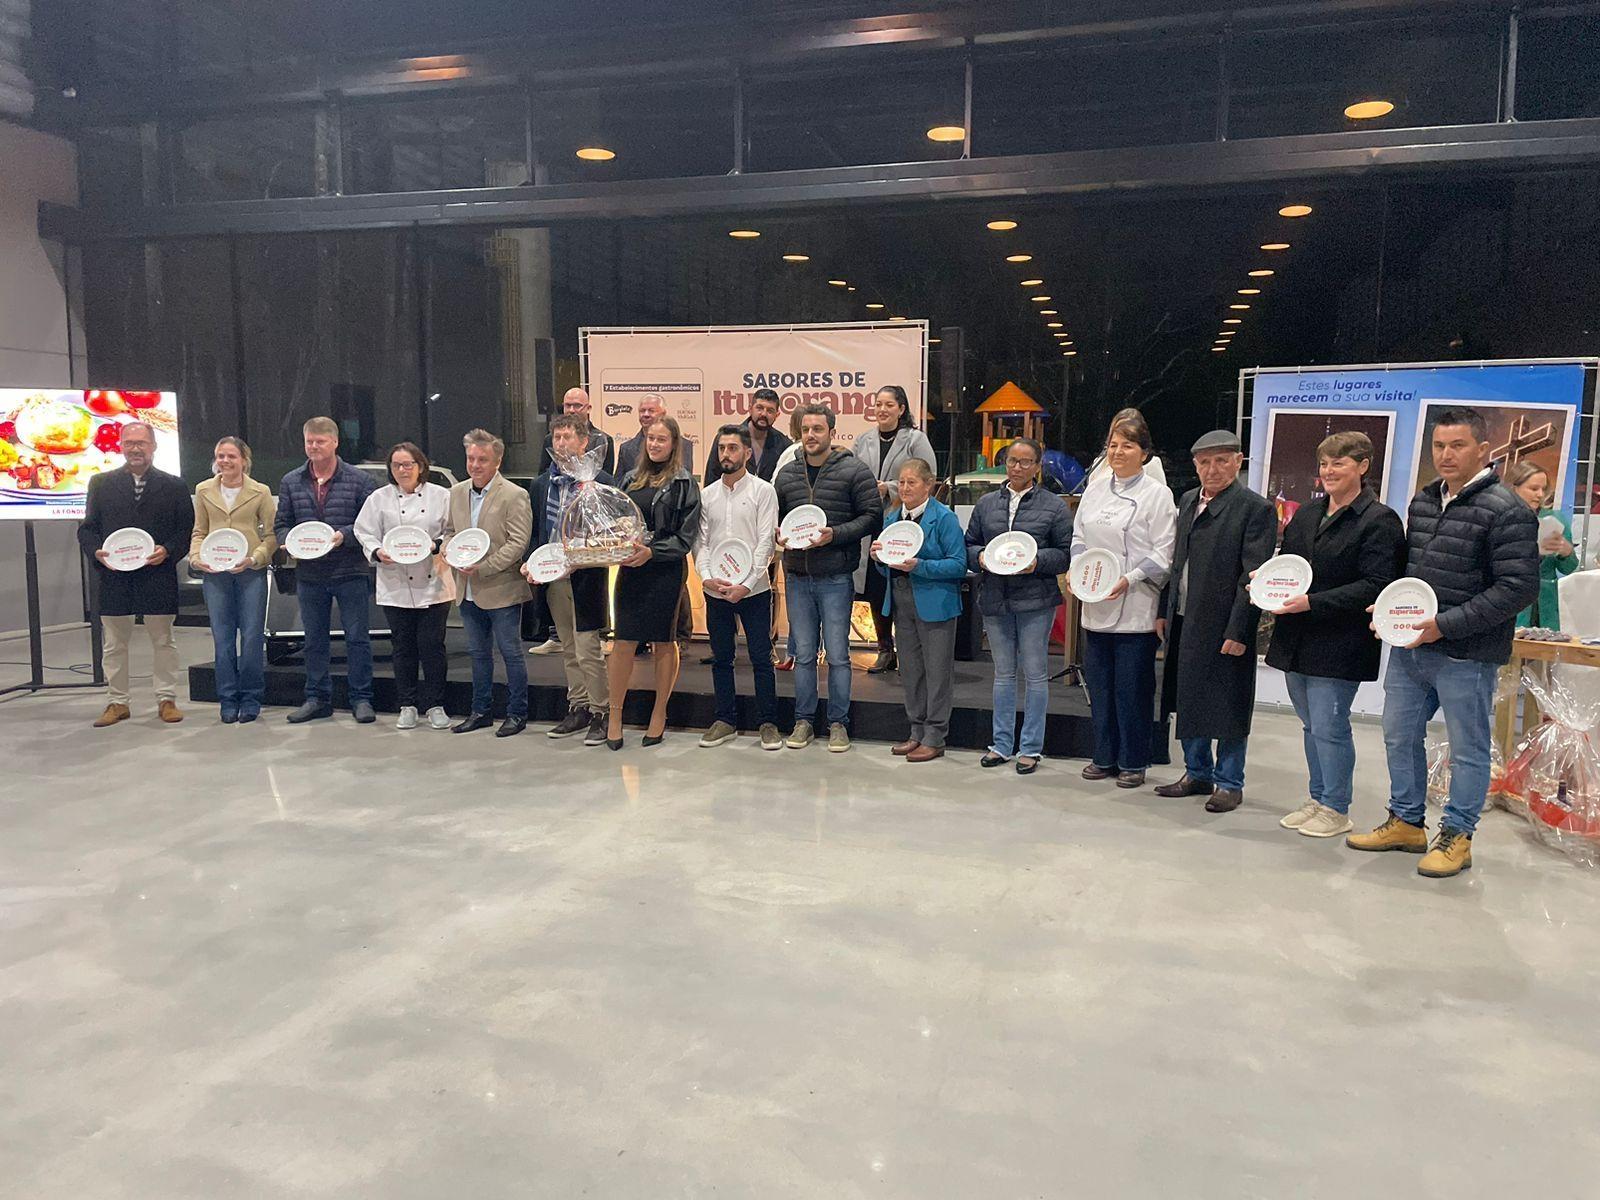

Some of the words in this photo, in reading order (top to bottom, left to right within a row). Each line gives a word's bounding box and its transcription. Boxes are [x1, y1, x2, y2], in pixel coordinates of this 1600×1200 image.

[742, 372, 833, 389] SABORES
[838, 371, 866, 387] DE
[1298, 380, 1330, 391] Estes
[1333, 379, 1382, 392] lugares
[1266, 393, 1329, 403] merecem
[1332, 393, 1342, 402] a
[1345, 392, 1370, 402] sua
[1374, 389, 1417, 402] visita!
